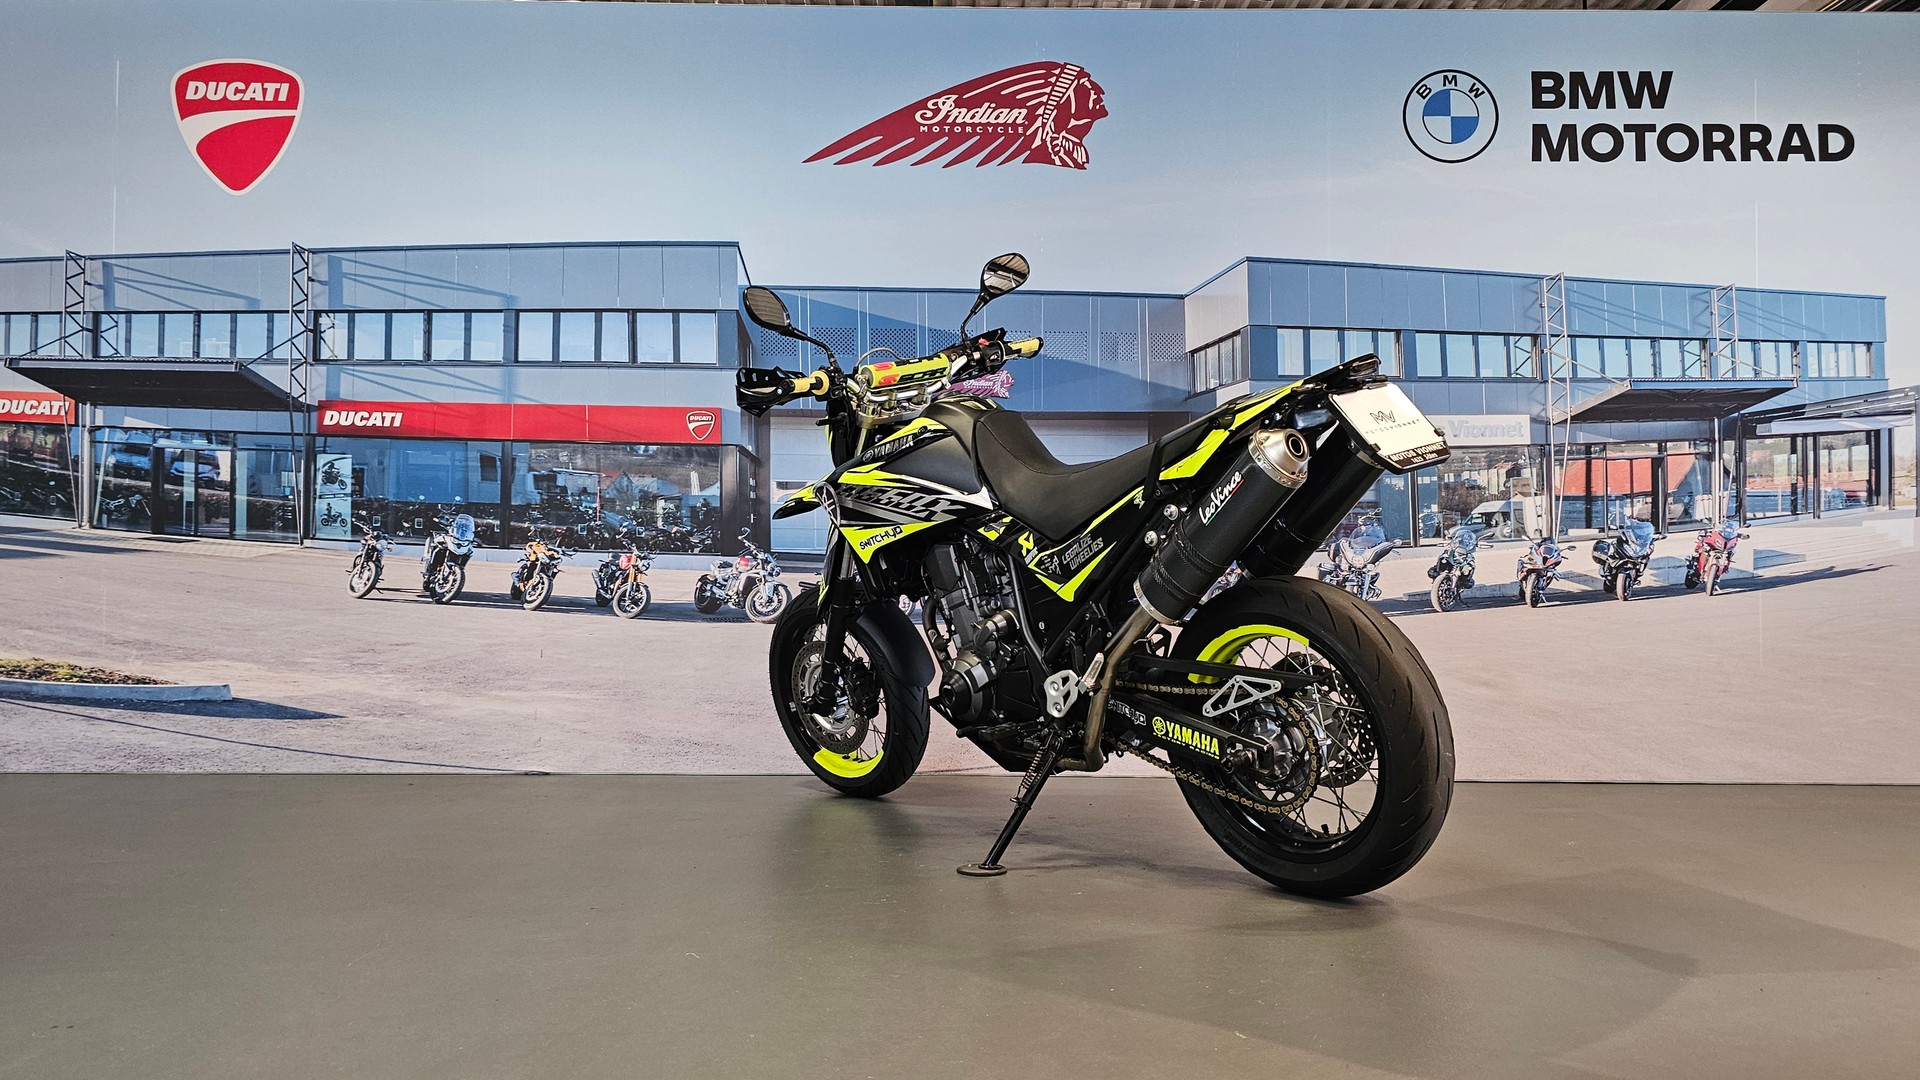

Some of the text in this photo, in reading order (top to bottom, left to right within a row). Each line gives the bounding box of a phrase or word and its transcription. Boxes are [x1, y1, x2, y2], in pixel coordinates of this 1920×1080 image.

[185, 81, 289, 101] DUCATI
[1415, 74, 1486, 100] BMW
[1531, 71, 1673, 109] BMW
[914, 94, 1027, 124] Indian
[1532, 123, 1855, 162] MOTORRAD
[323, 410, 403, 427] DUCATI
[1448, 420, 1524, 438] Vionnet
[873, 433, 914, 459] YAMAHA
[1390, 441, 1446, 461] MOTOS VIONNET
[1199, 471, 1242, 524] LeoVince
[1061, 533, 1093, 565] LEGALIZE
[1069, 537, 1104, 571] WHEELIES
[1166, 720, 1220, 756] YAMAHA
